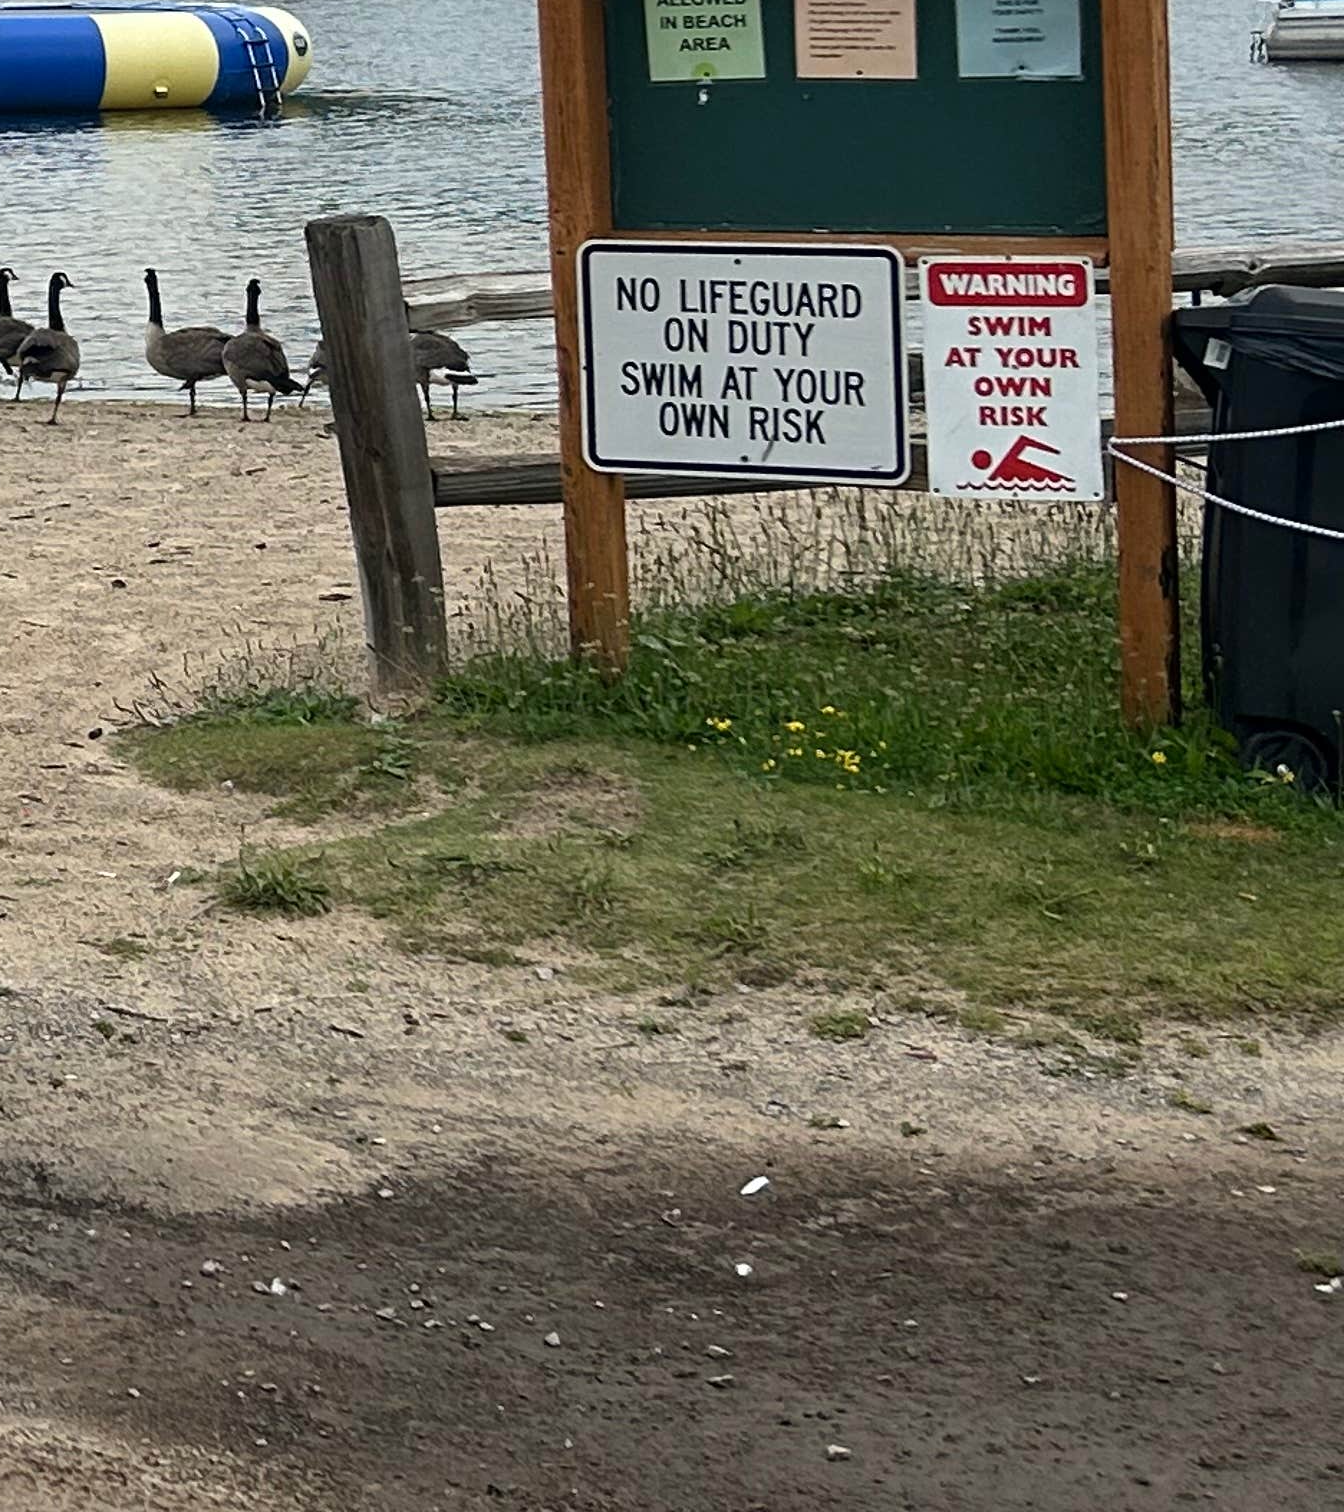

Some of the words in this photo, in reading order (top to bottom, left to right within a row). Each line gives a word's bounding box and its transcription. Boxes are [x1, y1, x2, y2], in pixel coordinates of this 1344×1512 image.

[660, 16, 677, 29] IN
[683, 14, 747, 29] BEACH
[679, 37, 731, 52] AREA
[939, 273, 1076, 297] WARNING
[616, 277, 660, 313] NO
[680, 279, 862, 318] LIFEGUARD
[967, 316, 1052, 337] SWIM
[664, 318, 708, 353] ON
[728, 320, 815, 357] DUTY
[944, 347, 982, 368] AT
[994, 347, 1080, 368] YOUR
[621, 361, 703, 399] SWIM
[721, 366, 758, 400] AT
[774, 368, 865, 407] YOUR
[974, 376, 1052, 397] OWN
[660, 401, 729, 438] OWN
[749, 406, 826, 445] RISK
[979, 406, 1048, 426] RISK
